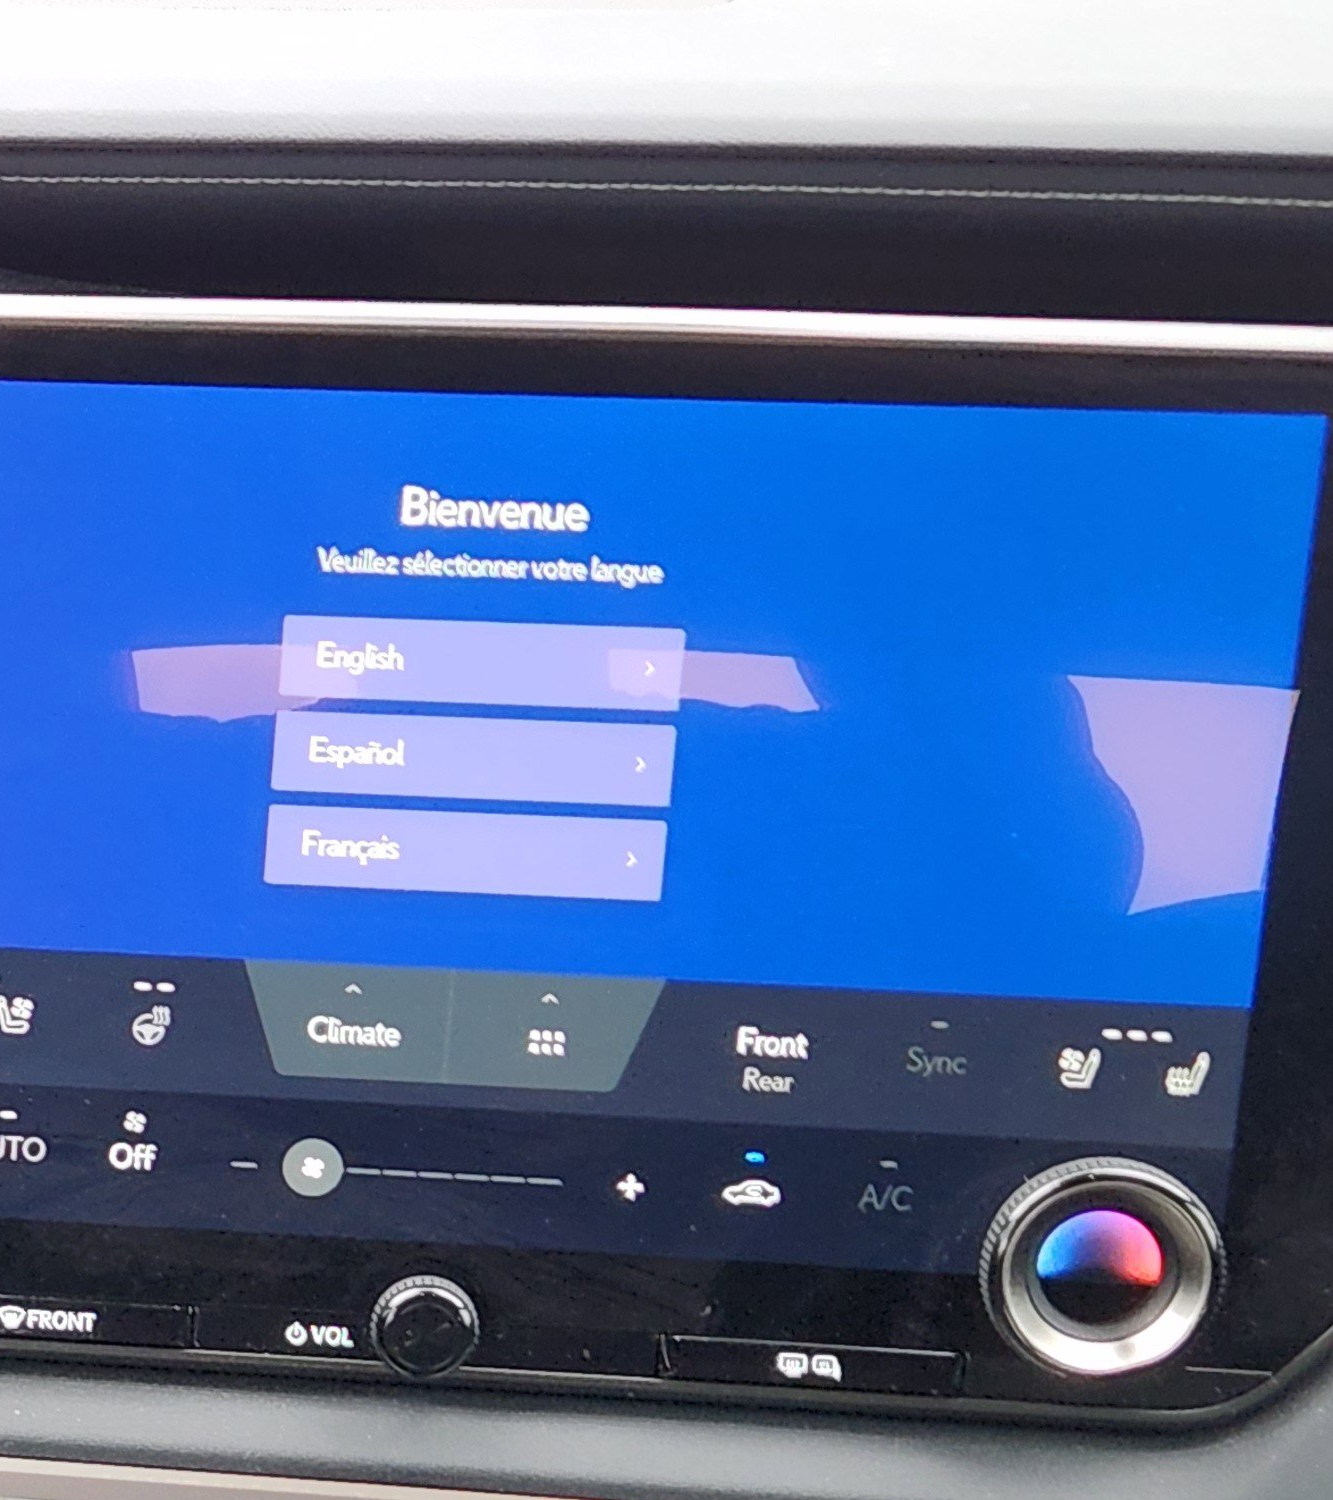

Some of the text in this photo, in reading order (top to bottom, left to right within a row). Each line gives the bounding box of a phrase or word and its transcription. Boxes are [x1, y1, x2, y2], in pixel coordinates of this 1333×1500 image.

[399, 484, 591, 533] Bienvenue
[316, 545, 665, 589] Veuillez sélectionner votre langue
[316, 639, 405, 676] English
[308, 735, 405, 771] Español
[301, 828, 401, 866] Français
[306, 1014, 402, 1049] Climate
[736, 1025, 810, 1060] Front
[905, 1046, 968, 1077] Sync
[741, 1065, 796, 1094] Rear
[108, 1141, 159, 1171] Off
[858, 1183, 913, 1214] A/C
[26, 1309, 98, 1333] FRONT
[309, 1324, 355, 1349] VOL
